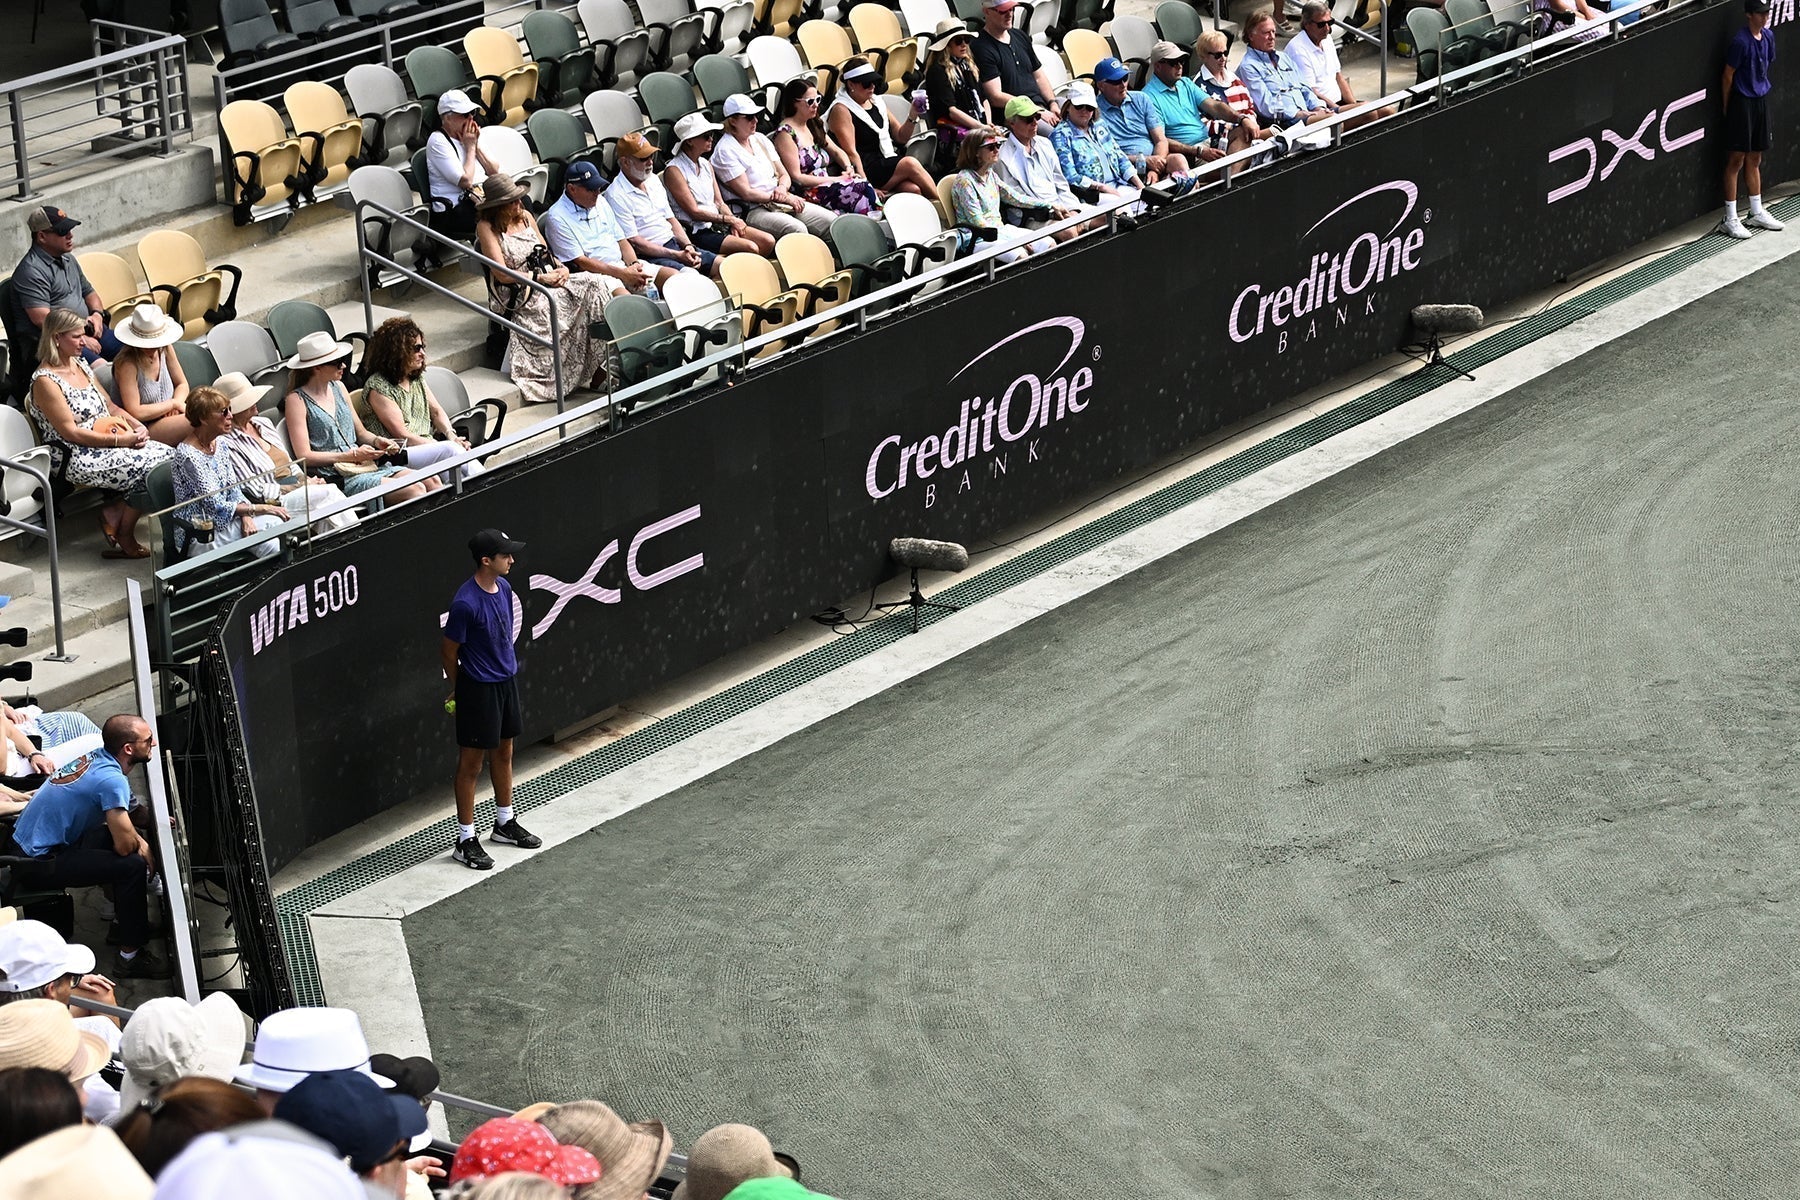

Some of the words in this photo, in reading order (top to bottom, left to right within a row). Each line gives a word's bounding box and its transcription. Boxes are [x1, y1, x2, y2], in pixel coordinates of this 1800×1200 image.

[1547, 88, 1707, 205] DXC
[1277, 292, 1377, 356] BANK
[924, 437, 1042, 510] BANK
[249, 583, 309, 656] WTA
[314, 564, 359, 618] 500
